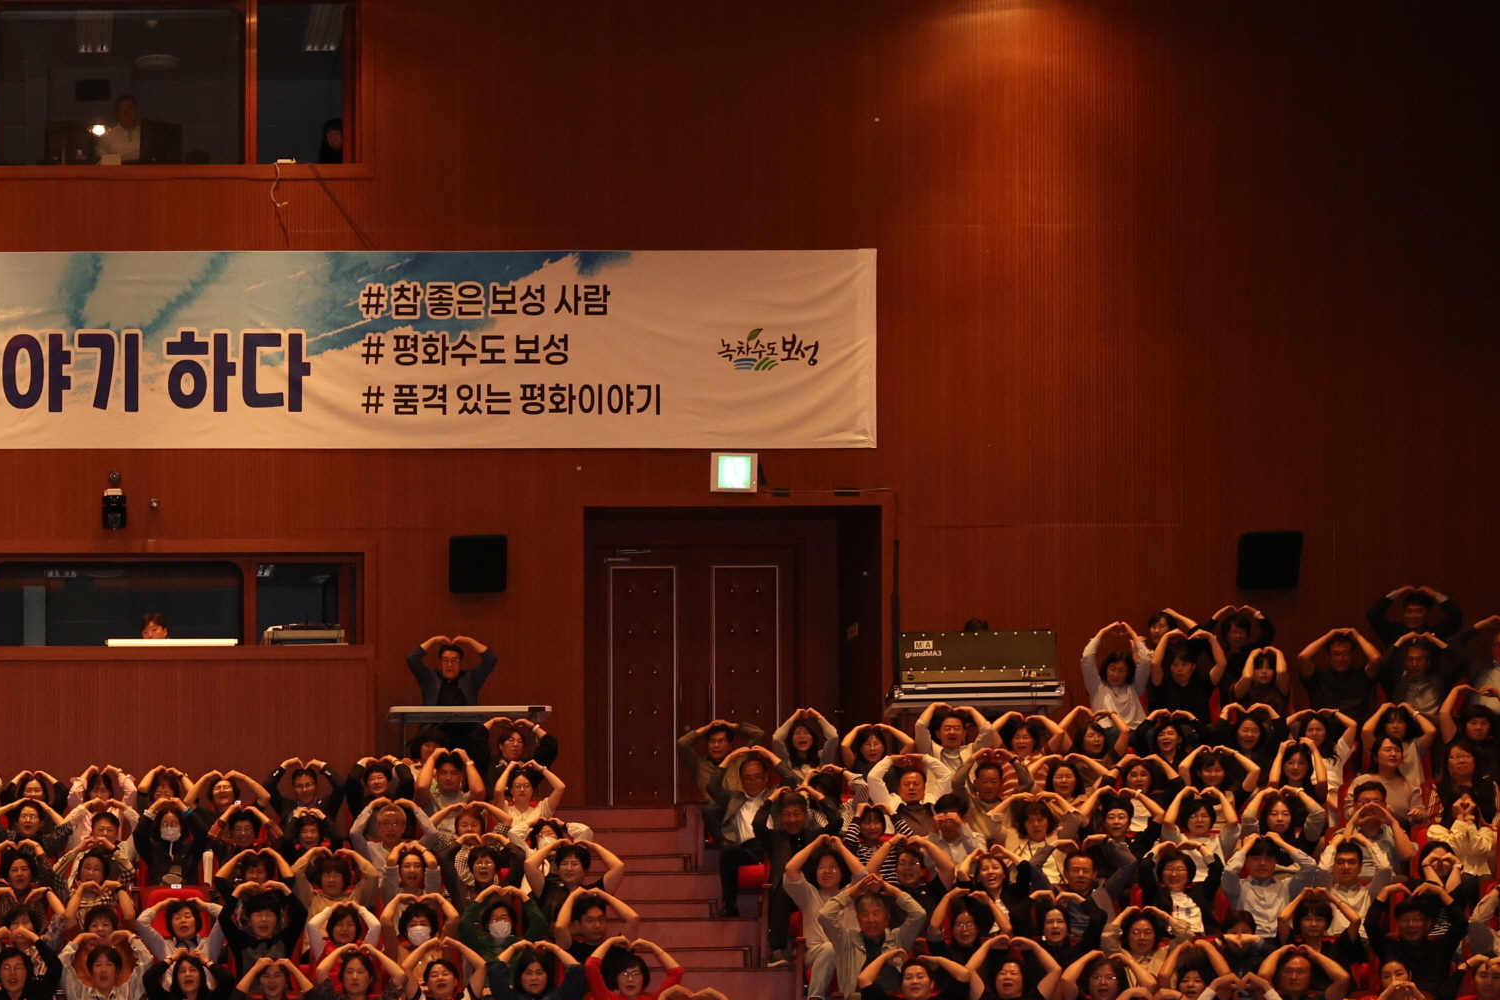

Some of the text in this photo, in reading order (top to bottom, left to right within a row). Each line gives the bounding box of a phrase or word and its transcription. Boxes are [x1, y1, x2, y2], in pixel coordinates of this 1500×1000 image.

[427, 285, 483, 316] 좋은
[490, 284, 546, 316] 보성
[554, 284, 611, 316] 사람
[392, 334, 507, 366] 평화수도
[513, 334, 569, 366] 보성
[166, 330, 311, 413] 하다
[392, 384, 447, 416] 품격
[456, 384, 512, 415] 있는
[519, 383, 662, 416] 평화이야기
[905, 650, 942, 659] grandMA3
